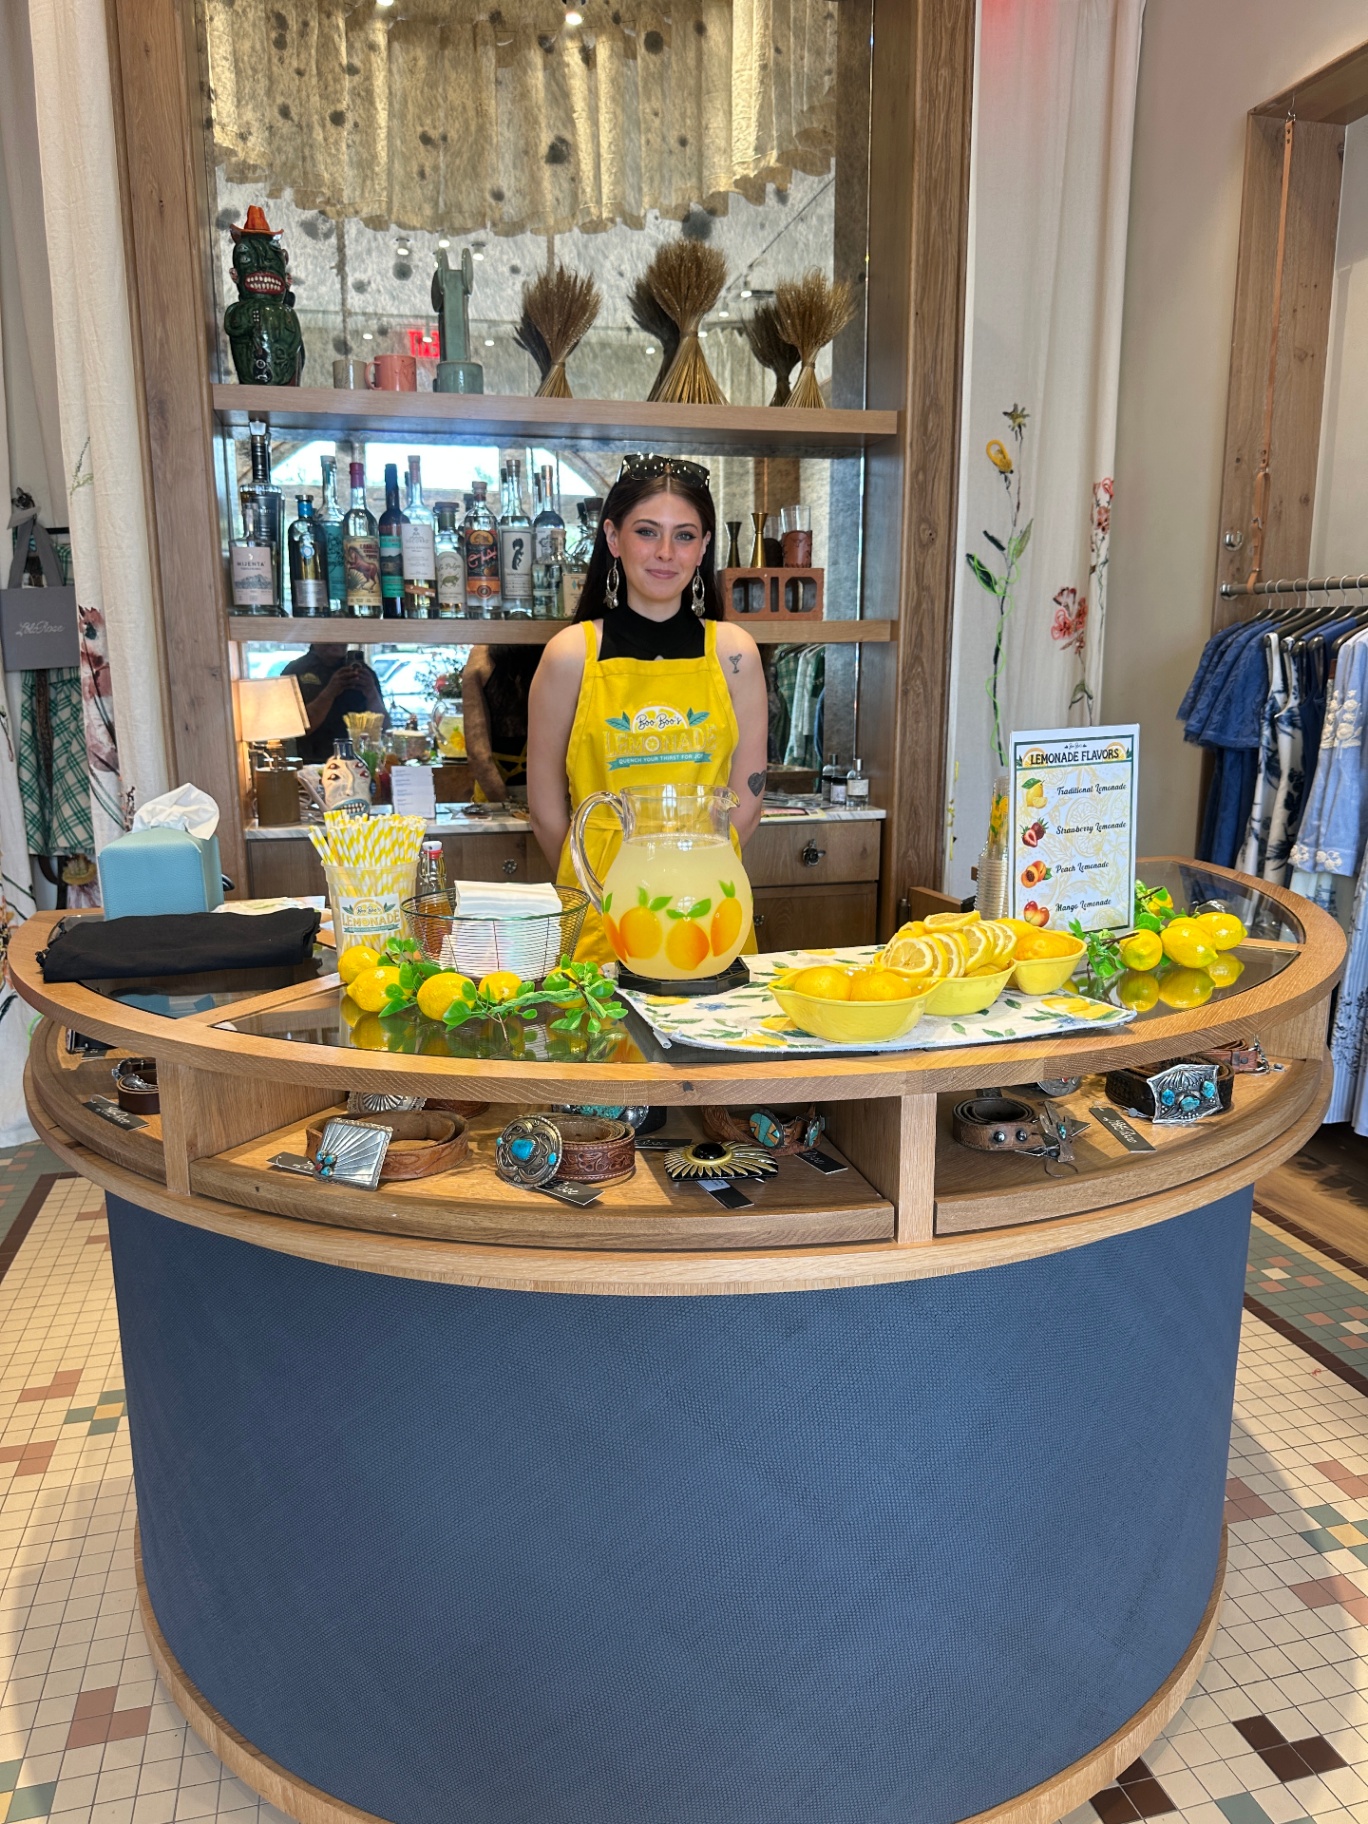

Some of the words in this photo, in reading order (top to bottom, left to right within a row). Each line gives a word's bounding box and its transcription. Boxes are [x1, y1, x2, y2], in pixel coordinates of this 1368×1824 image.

[636, 713, 654, 730] Boo
[656, 712, 682, 729] Boo's
[602, 724, 717, 758] LEMONADE
[1030, 751, 1079, 765] LEMONADE
[1081, 748, 1119, 761] FLAVORS
[1056, 786, 1094, 795] Traditional
[1094, 783, 1127, 794] Lemonade
[1056, 825, 1094, 835] Strawberry
[1094, 821, 1127, 832] Lemonade
[1055, 864, 1076, 873] Peach
[1077, 861, 1109, 873] Lemonade
[1055, 902, 1079, 912] Mango
[1079, 898, 1112, 910] Lemonade
[341, 909, 400, 927] LEMONADE
